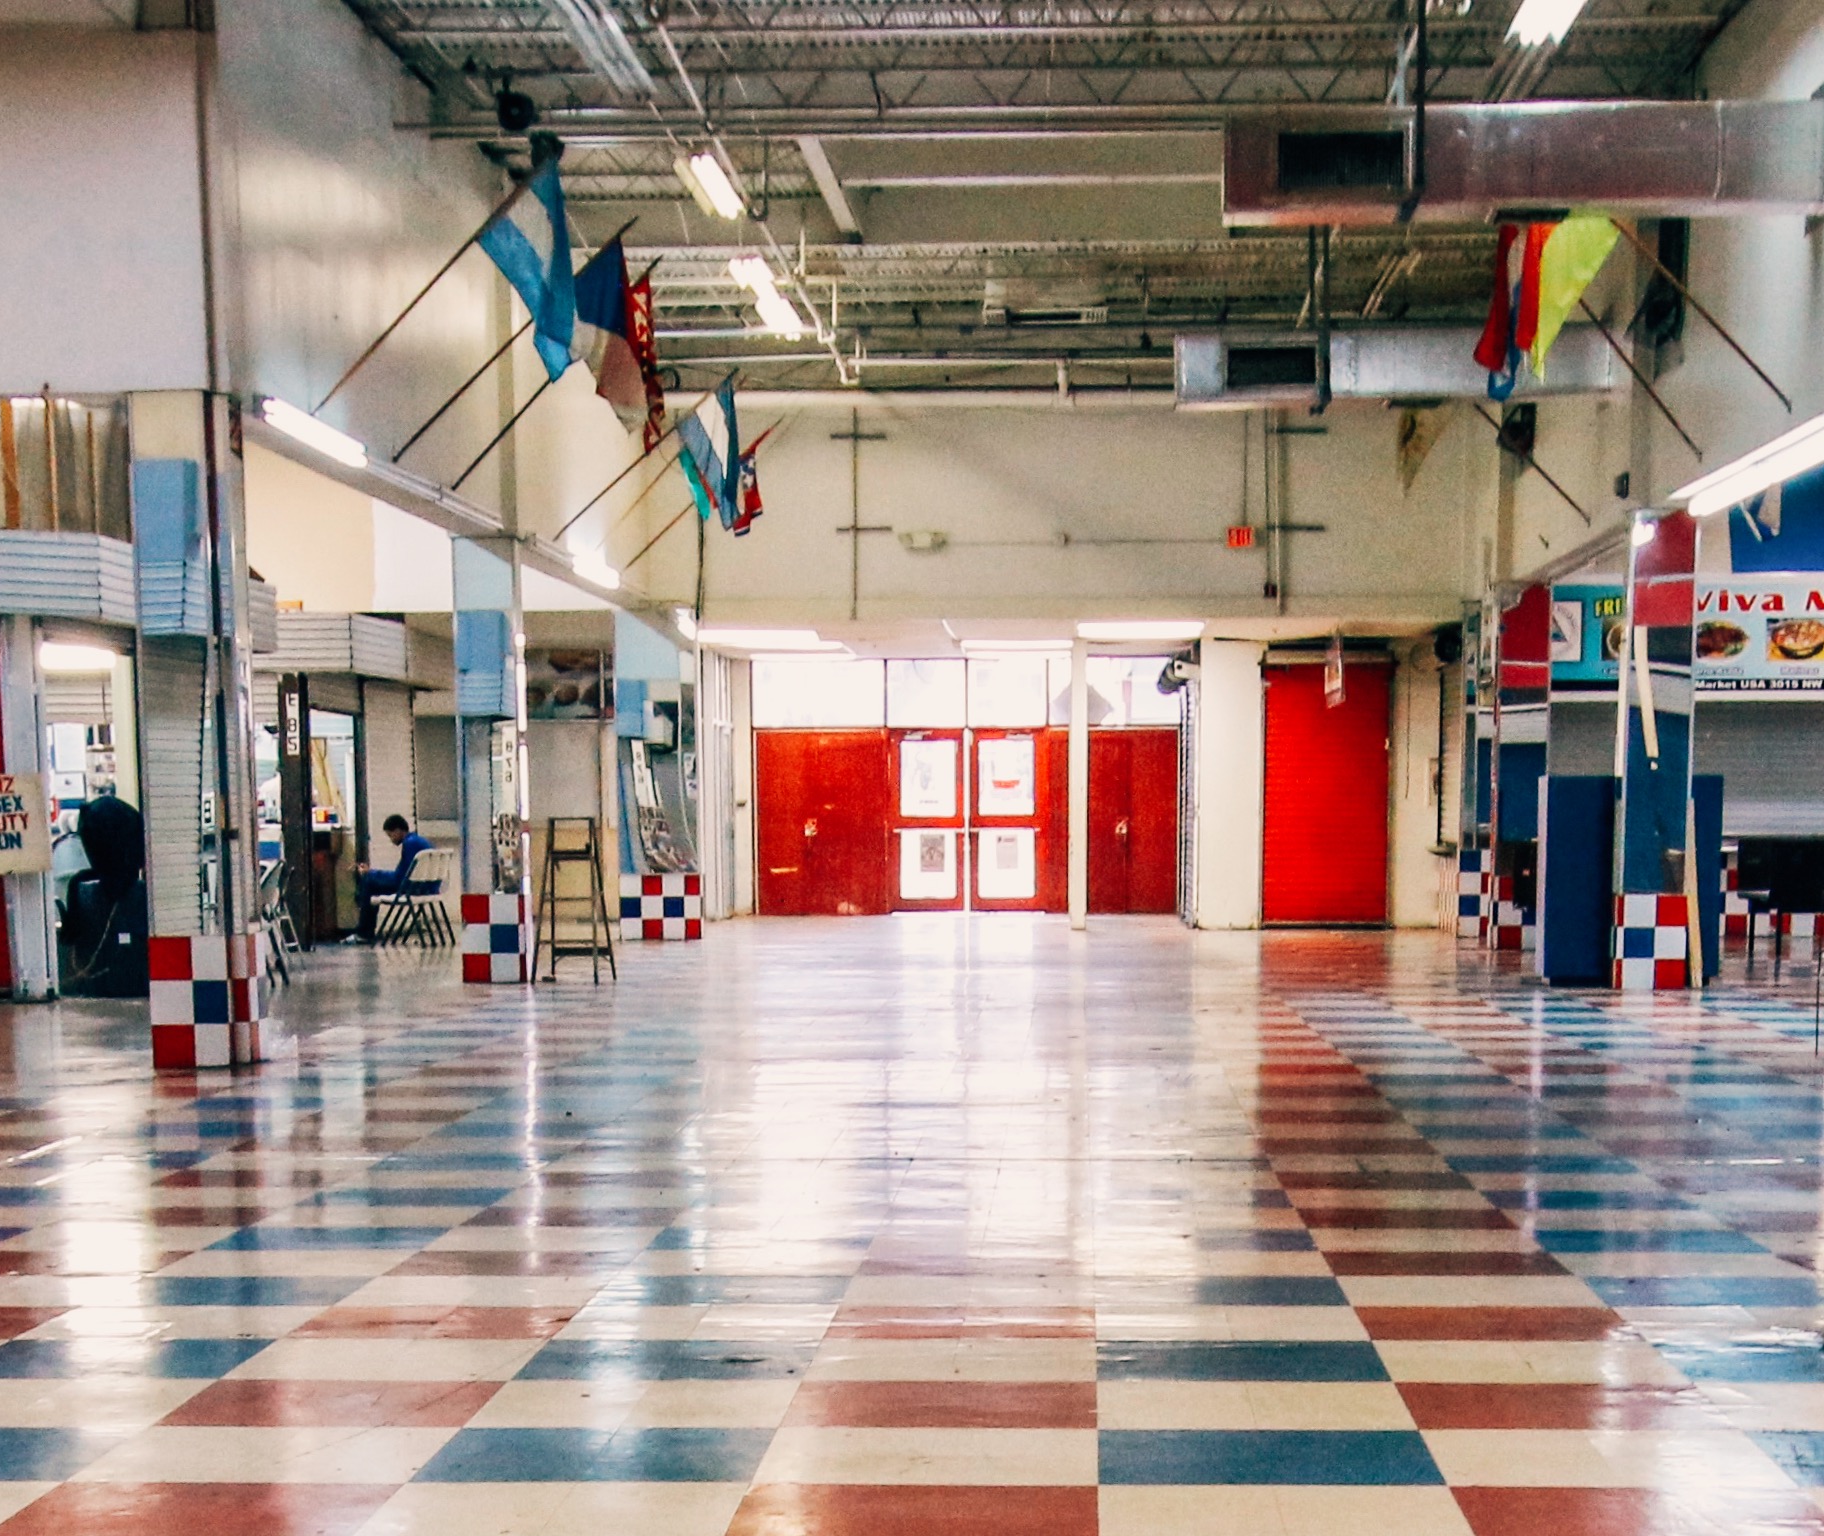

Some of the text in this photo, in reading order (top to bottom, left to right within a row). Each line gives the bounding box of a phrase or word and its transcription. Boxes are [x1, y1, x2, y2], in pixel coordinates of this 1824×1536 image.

[1695, 679, 1737, 690] Market
[1741, 679, 1766, 689] USA
[1802, 679, 1824, 689] NW
